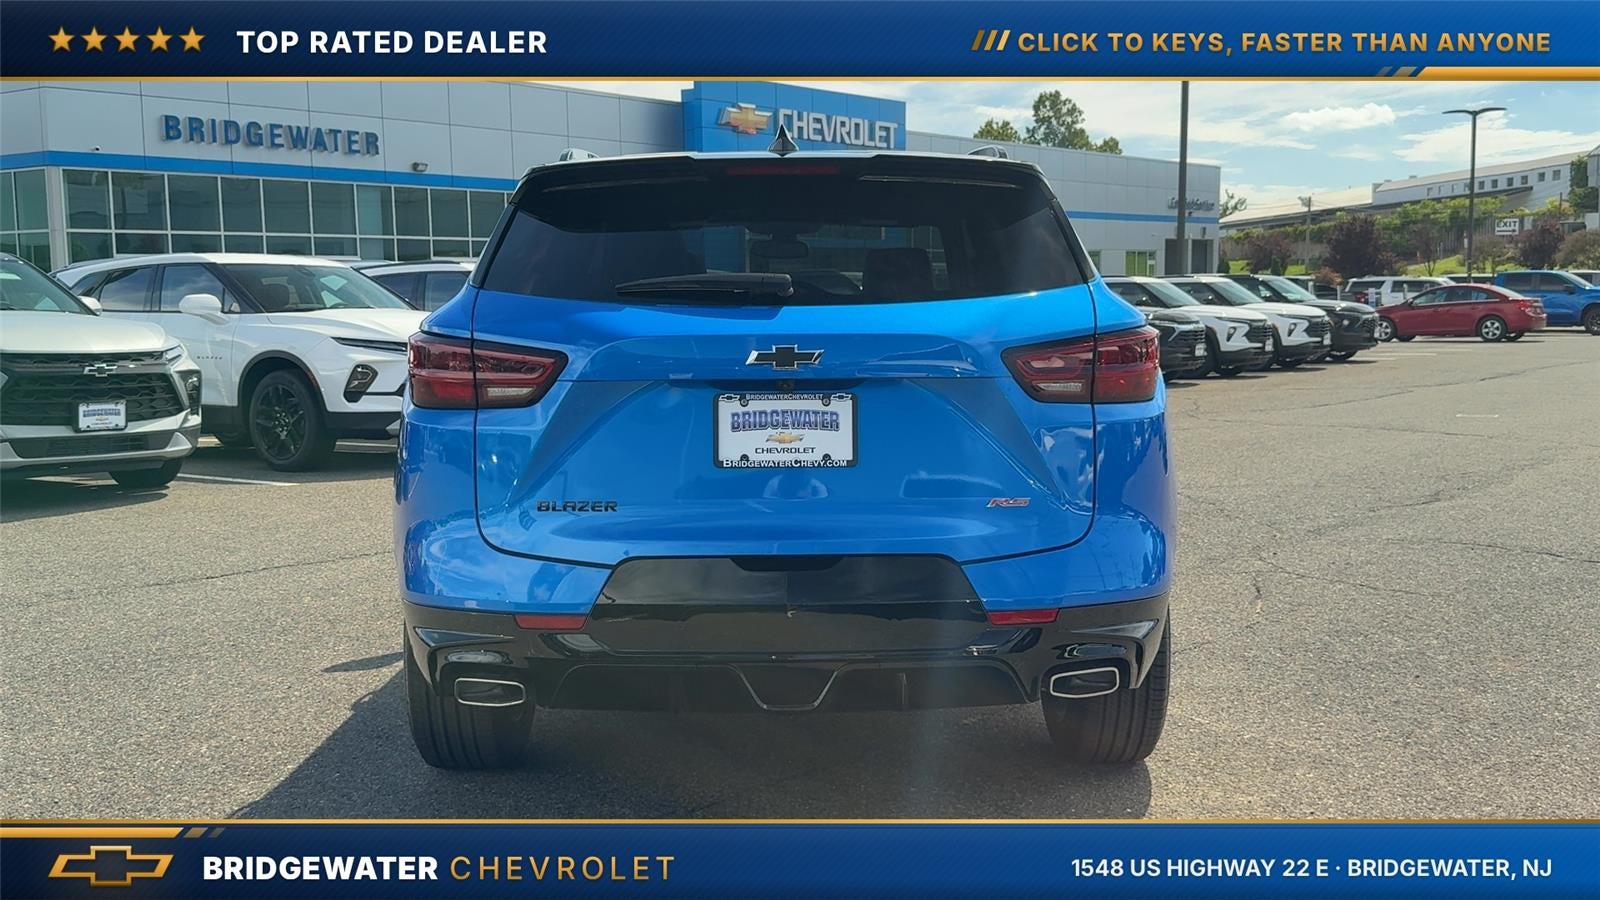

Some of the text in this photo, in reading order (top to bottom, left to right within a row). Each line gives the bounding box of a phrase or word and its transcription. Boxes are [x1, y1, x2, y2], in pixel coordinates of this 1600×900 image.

[161, 114, 380, 156] BRIDGEWATER
[778, 108, 898, 149] CHEVROLET
[1496, 220, 1517, 228] EXIT
[730, 409, 840, 432] BRIDGEWATER
[754, 446, 817, 455] CHEVROLET
[536, 500, 618, 513] BLAZER
[986, 497, 1031, 508] RS
